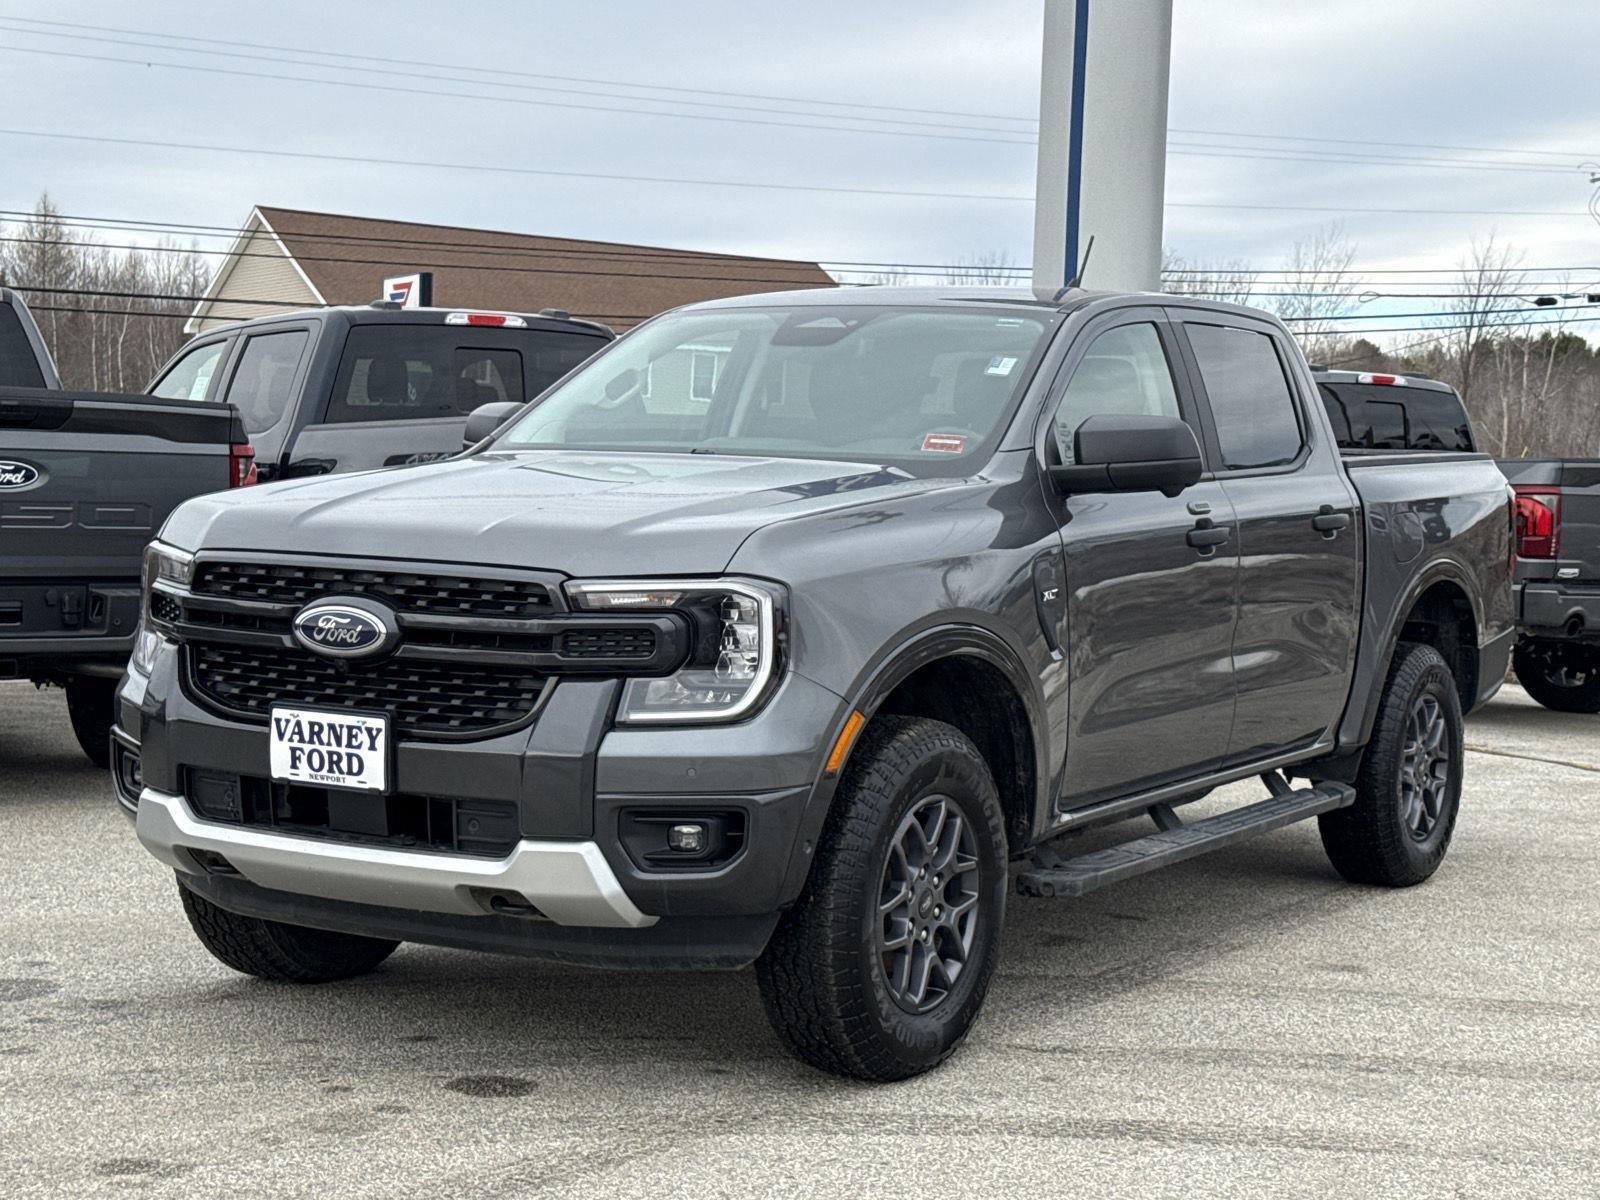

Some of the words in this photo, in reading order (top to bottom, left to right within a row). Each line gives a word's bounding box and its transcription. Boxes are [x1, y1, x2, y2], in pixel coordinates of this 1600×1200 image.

[313, 615, 361, 643] Ford
[274, 717, 383, 752] VARNEY
[288, 746, 365, 777] FORD
[308, 773, 346, 784] NEWPORT
